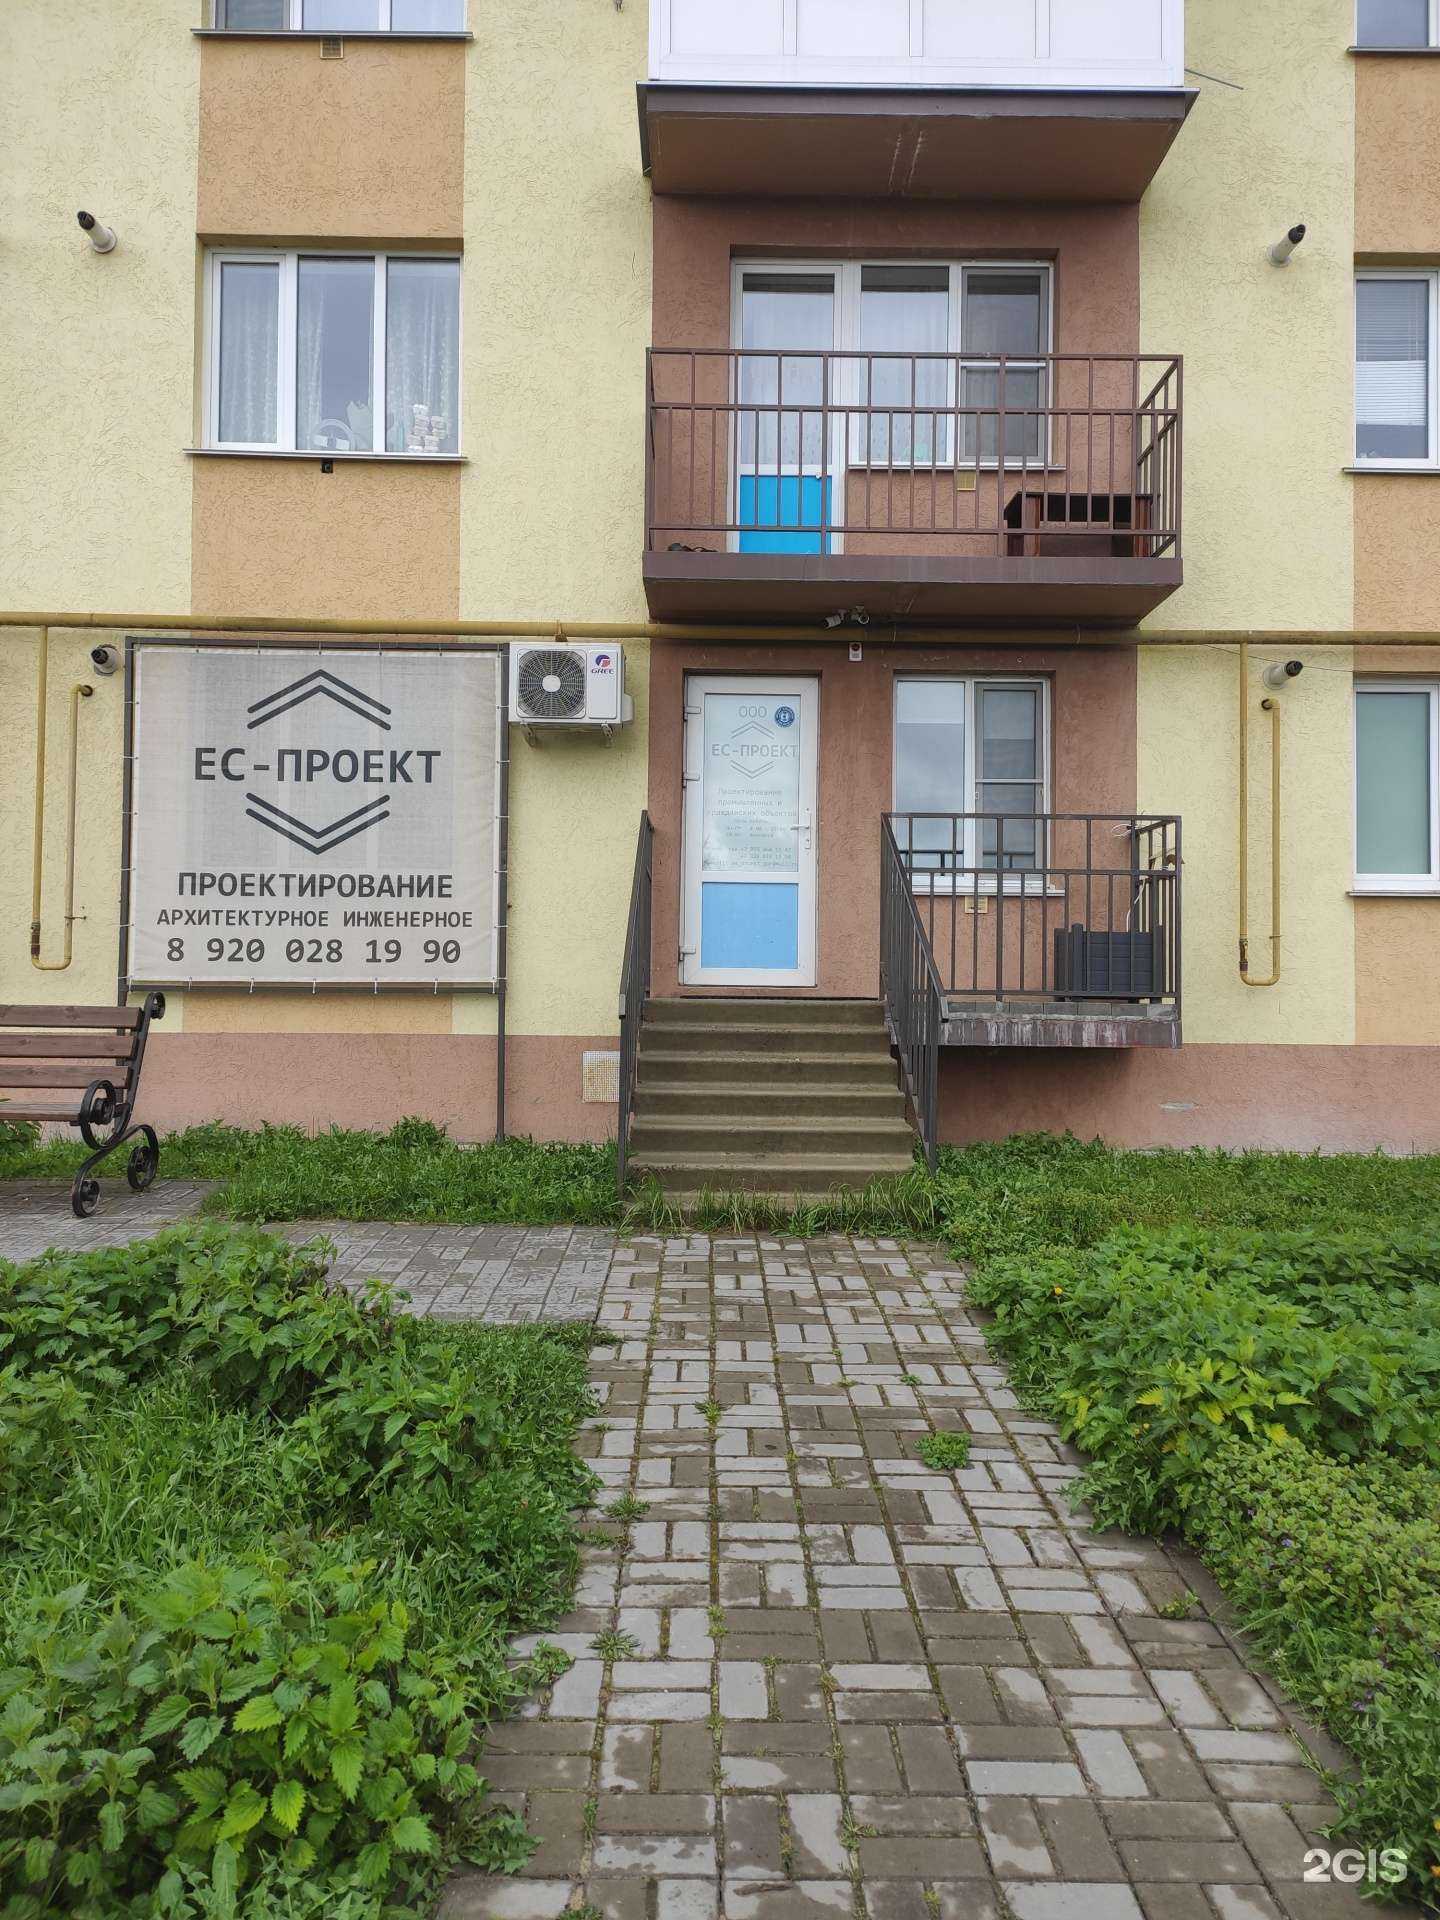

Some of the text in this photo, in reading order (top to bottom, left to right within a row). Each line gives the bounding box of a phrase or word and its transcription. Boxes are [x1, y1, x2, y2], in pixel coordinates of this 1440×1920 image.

[738, 705, 768, 718] ООО
[711, 743, 799, 758] ЕС-ПРОЕКТ
[194, 747, 442, 783] ЕС-ПРОЕКТ
[178, 872, 453, 898] ПРОЕКТИРОВАНИЕ
[156, 909, 473, 928] АРХИТЕКТУРНОЕ ИНЖЕНЕРНОЕ
[166, 937, 461, 964] 8 920 028 19 90
